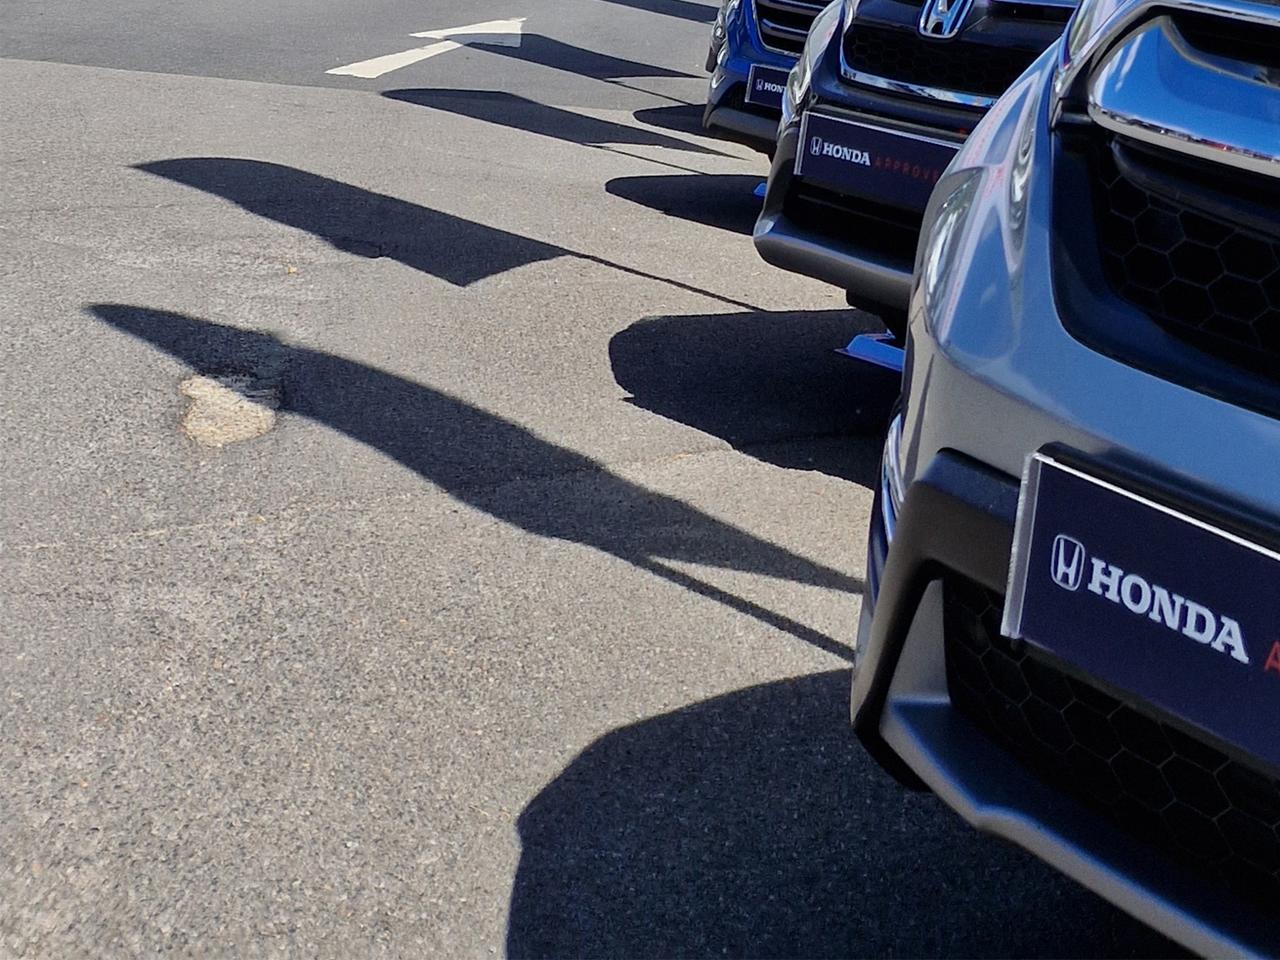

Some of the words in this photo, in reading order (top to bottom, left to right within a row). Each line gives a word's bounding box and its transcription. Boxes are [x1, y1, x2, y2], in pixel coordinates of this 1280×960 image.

[764, 82, 786, 93] HON
[822, 142, 871, 166] HONDA
[873, 156, 940, 178] APPROVE
[1087, 557, 1250, 664] HONDA
